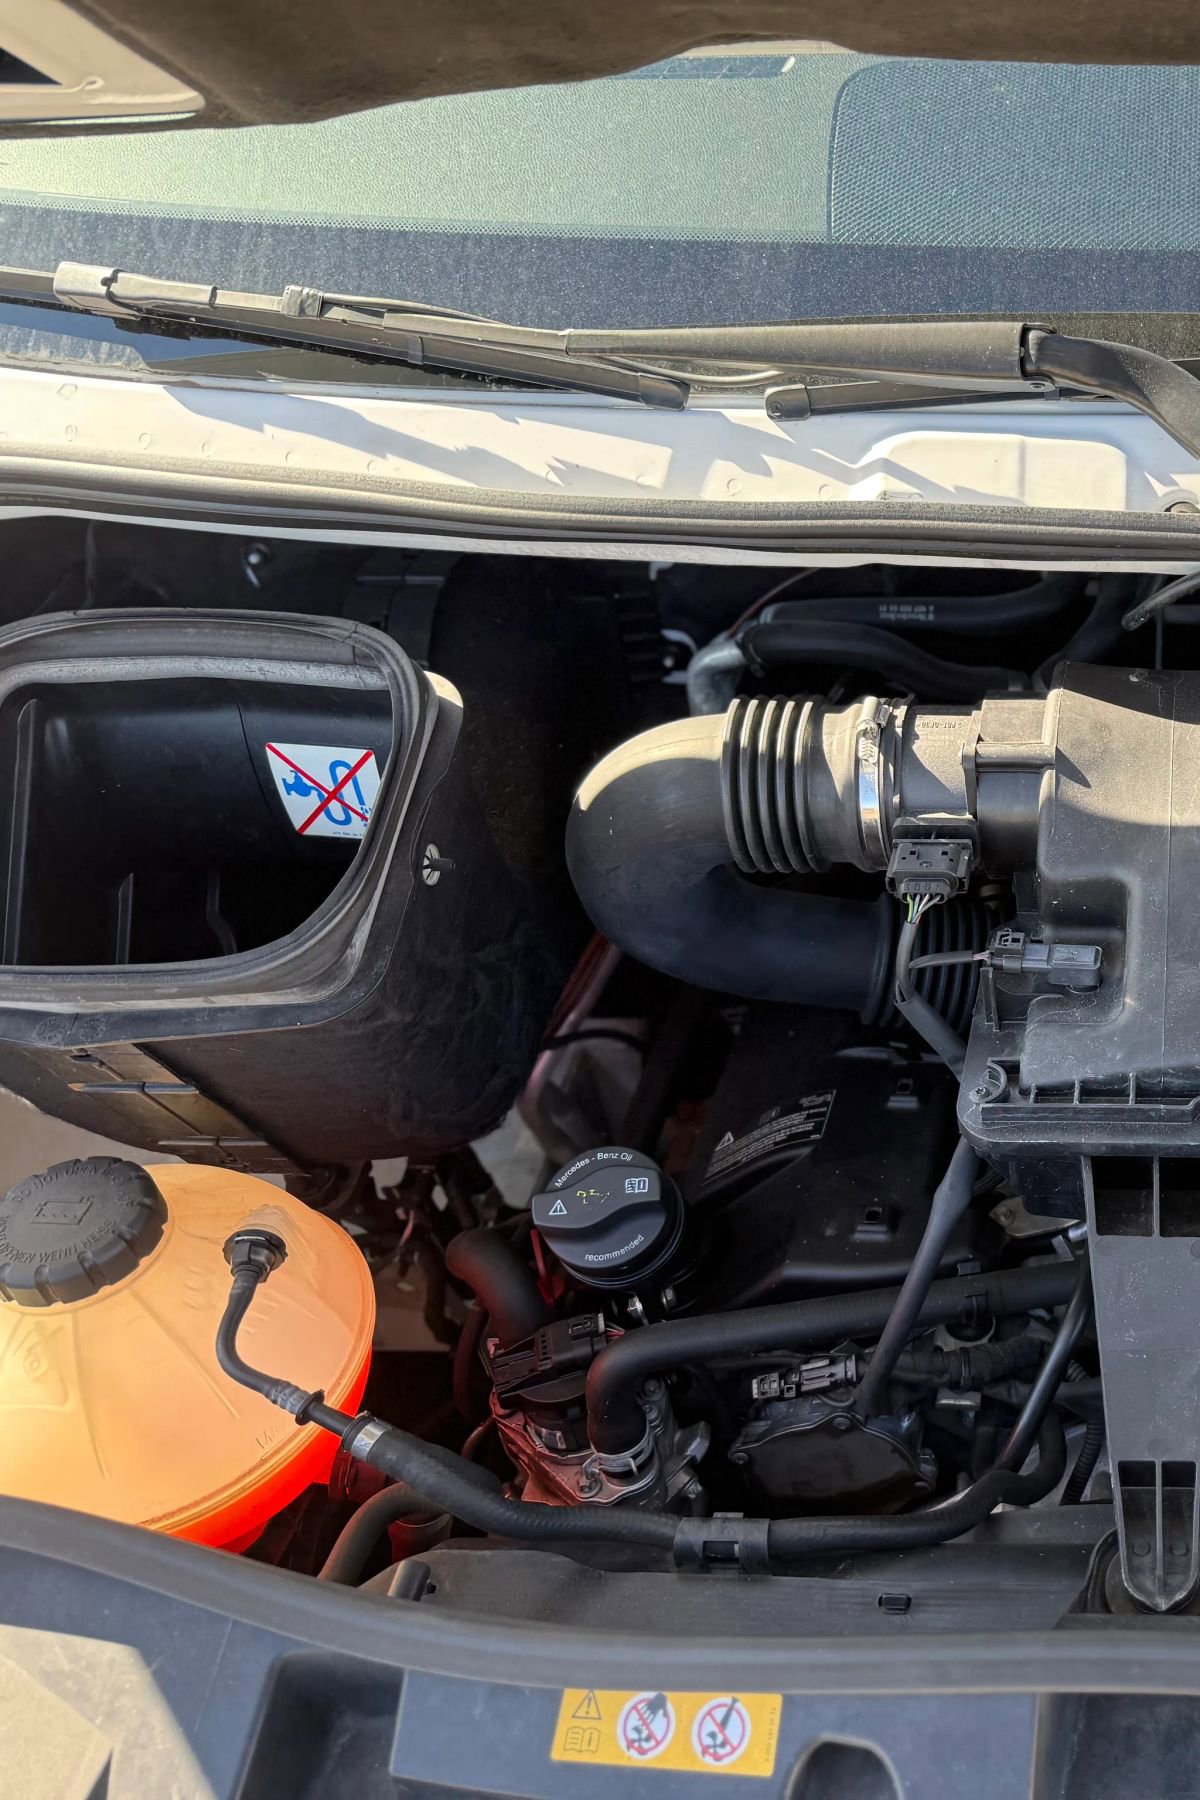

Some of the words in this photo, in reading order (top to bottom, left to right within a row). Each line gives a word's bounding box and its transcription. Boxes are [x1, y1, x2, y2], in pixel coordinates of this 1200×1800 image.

[554, 1158, 590, 1188] Mercedes
[597, 1152, 618, 1160] Benz
[620, 1153, 633, 1161] Oil
[585, 1234, 644, 1262] recommended
